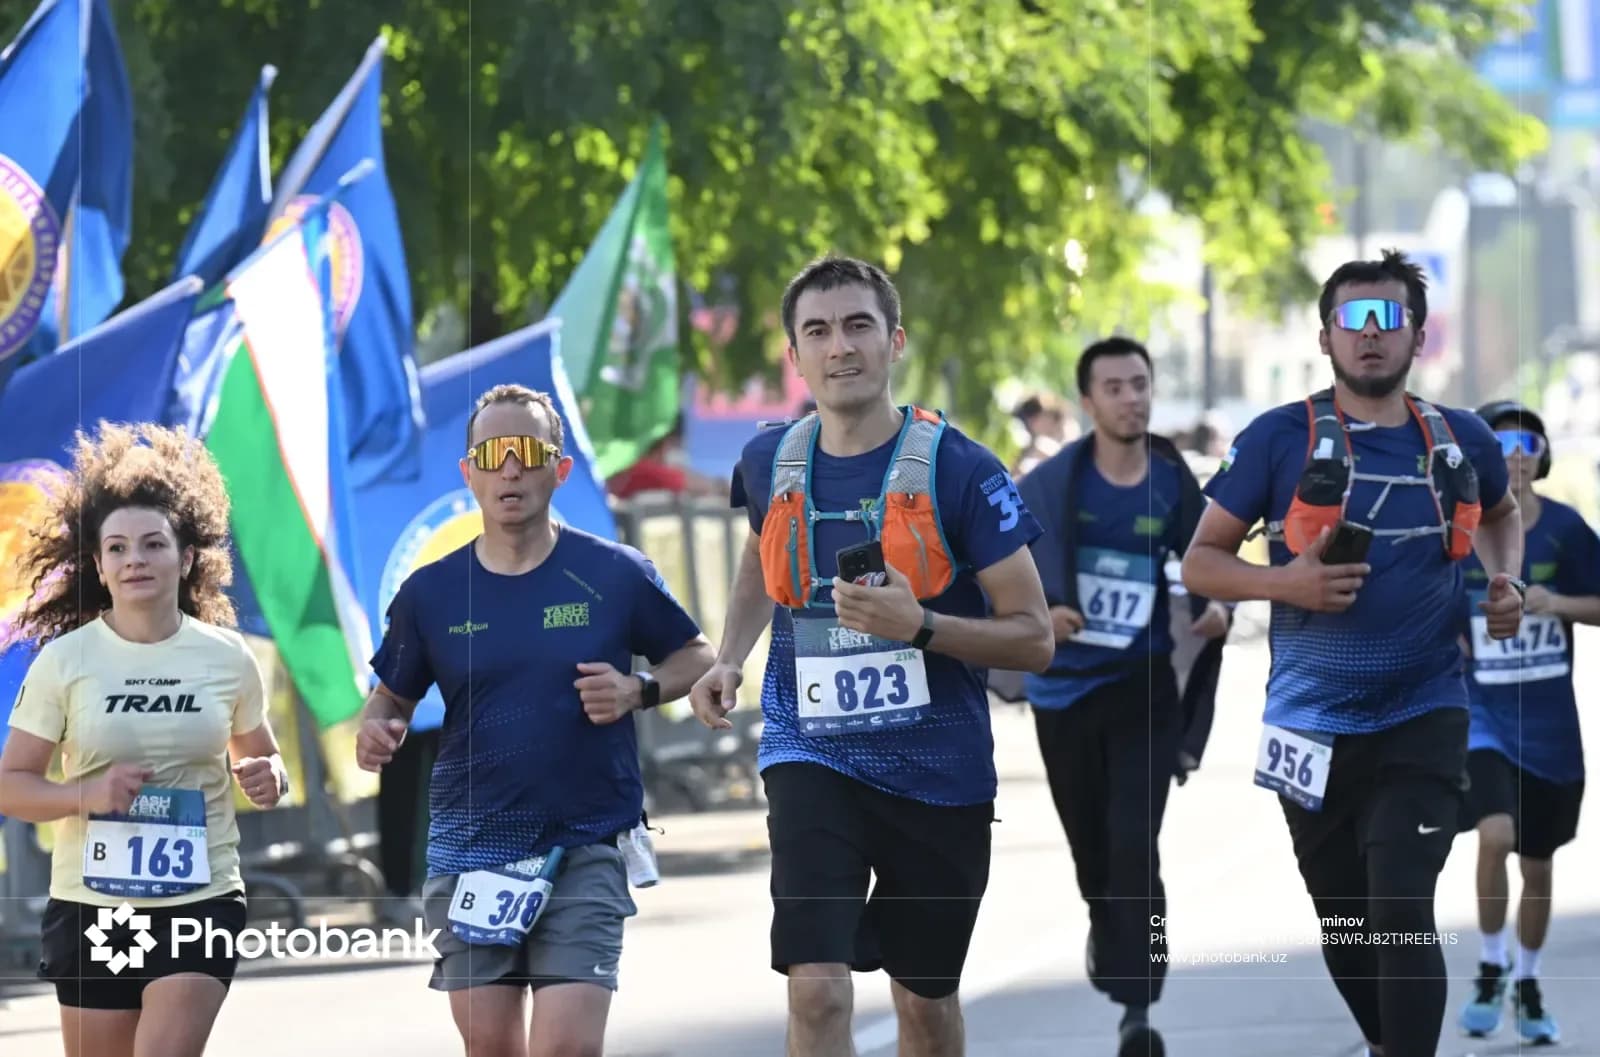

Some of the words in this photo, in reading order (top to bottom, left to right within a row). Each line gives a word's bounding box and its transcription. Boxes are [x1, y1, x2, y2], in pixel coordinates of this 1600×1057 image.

[1088, 587, 1141, 620] 617
[894, 651, 918, 662] 21K
[148, 678, 181, 687] CAMP
[807, 683, 821, 704] C
[834, 664, 909, 712] 823
[105, 694, 202, 713] TRAIL
[1267, 737, 1314, 788] 956
[93, 842, 106, 861] B
[127, 836, 194, 878] 163
[460, 891, 476, 910] B
